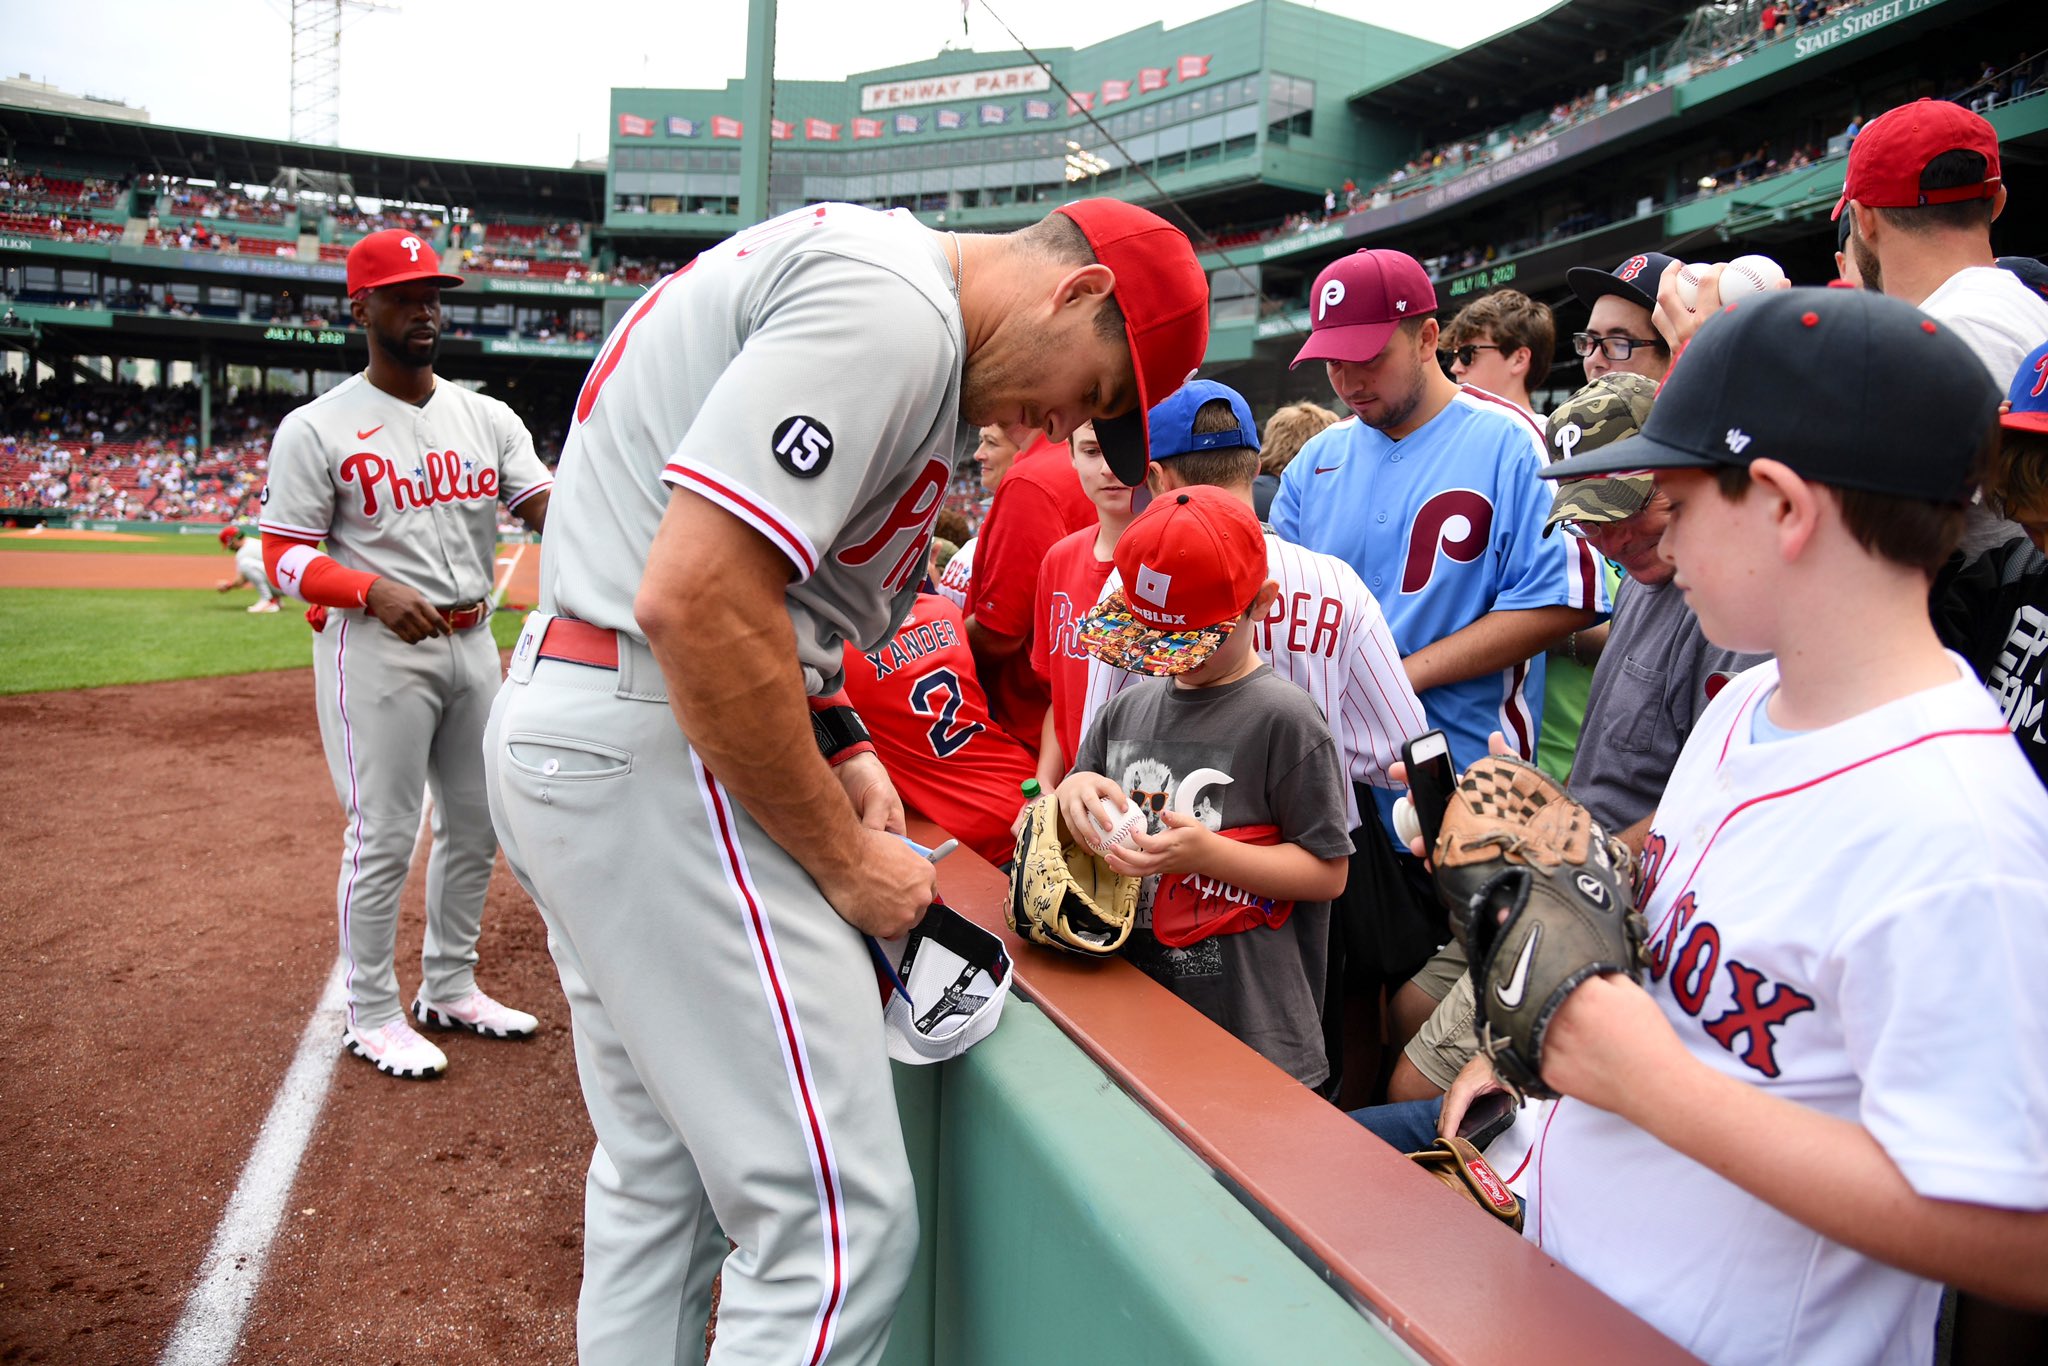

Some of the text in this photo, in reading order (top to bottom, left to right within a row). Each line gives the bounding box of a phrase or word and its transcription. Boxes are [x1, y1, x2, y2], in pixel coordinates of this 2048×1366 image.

[1795, 1, 1902, 58] STATE STREET
[873, 71, 1037, 103] FENWAY PARK
[400, 237, 421, 262] P
[1619, 255, 1649, 282] B
[1318, 279, 1345, 321] P
[1449, 277, 1474, 296] JULY
[1492, 262, 1516, 285] 2021
[264, 328, 294, 340] JULY
[317, 331, 345, 345] 2021
[775, 418, 830, 472] 15
[1554, 424, 1582, 460] P
[1399, 487, 1495, 596] P
[865, 619, 961, 681] XANDER
[908, 666, 987, 759] 2
[1650, 890, 1816, 1079] SOX
